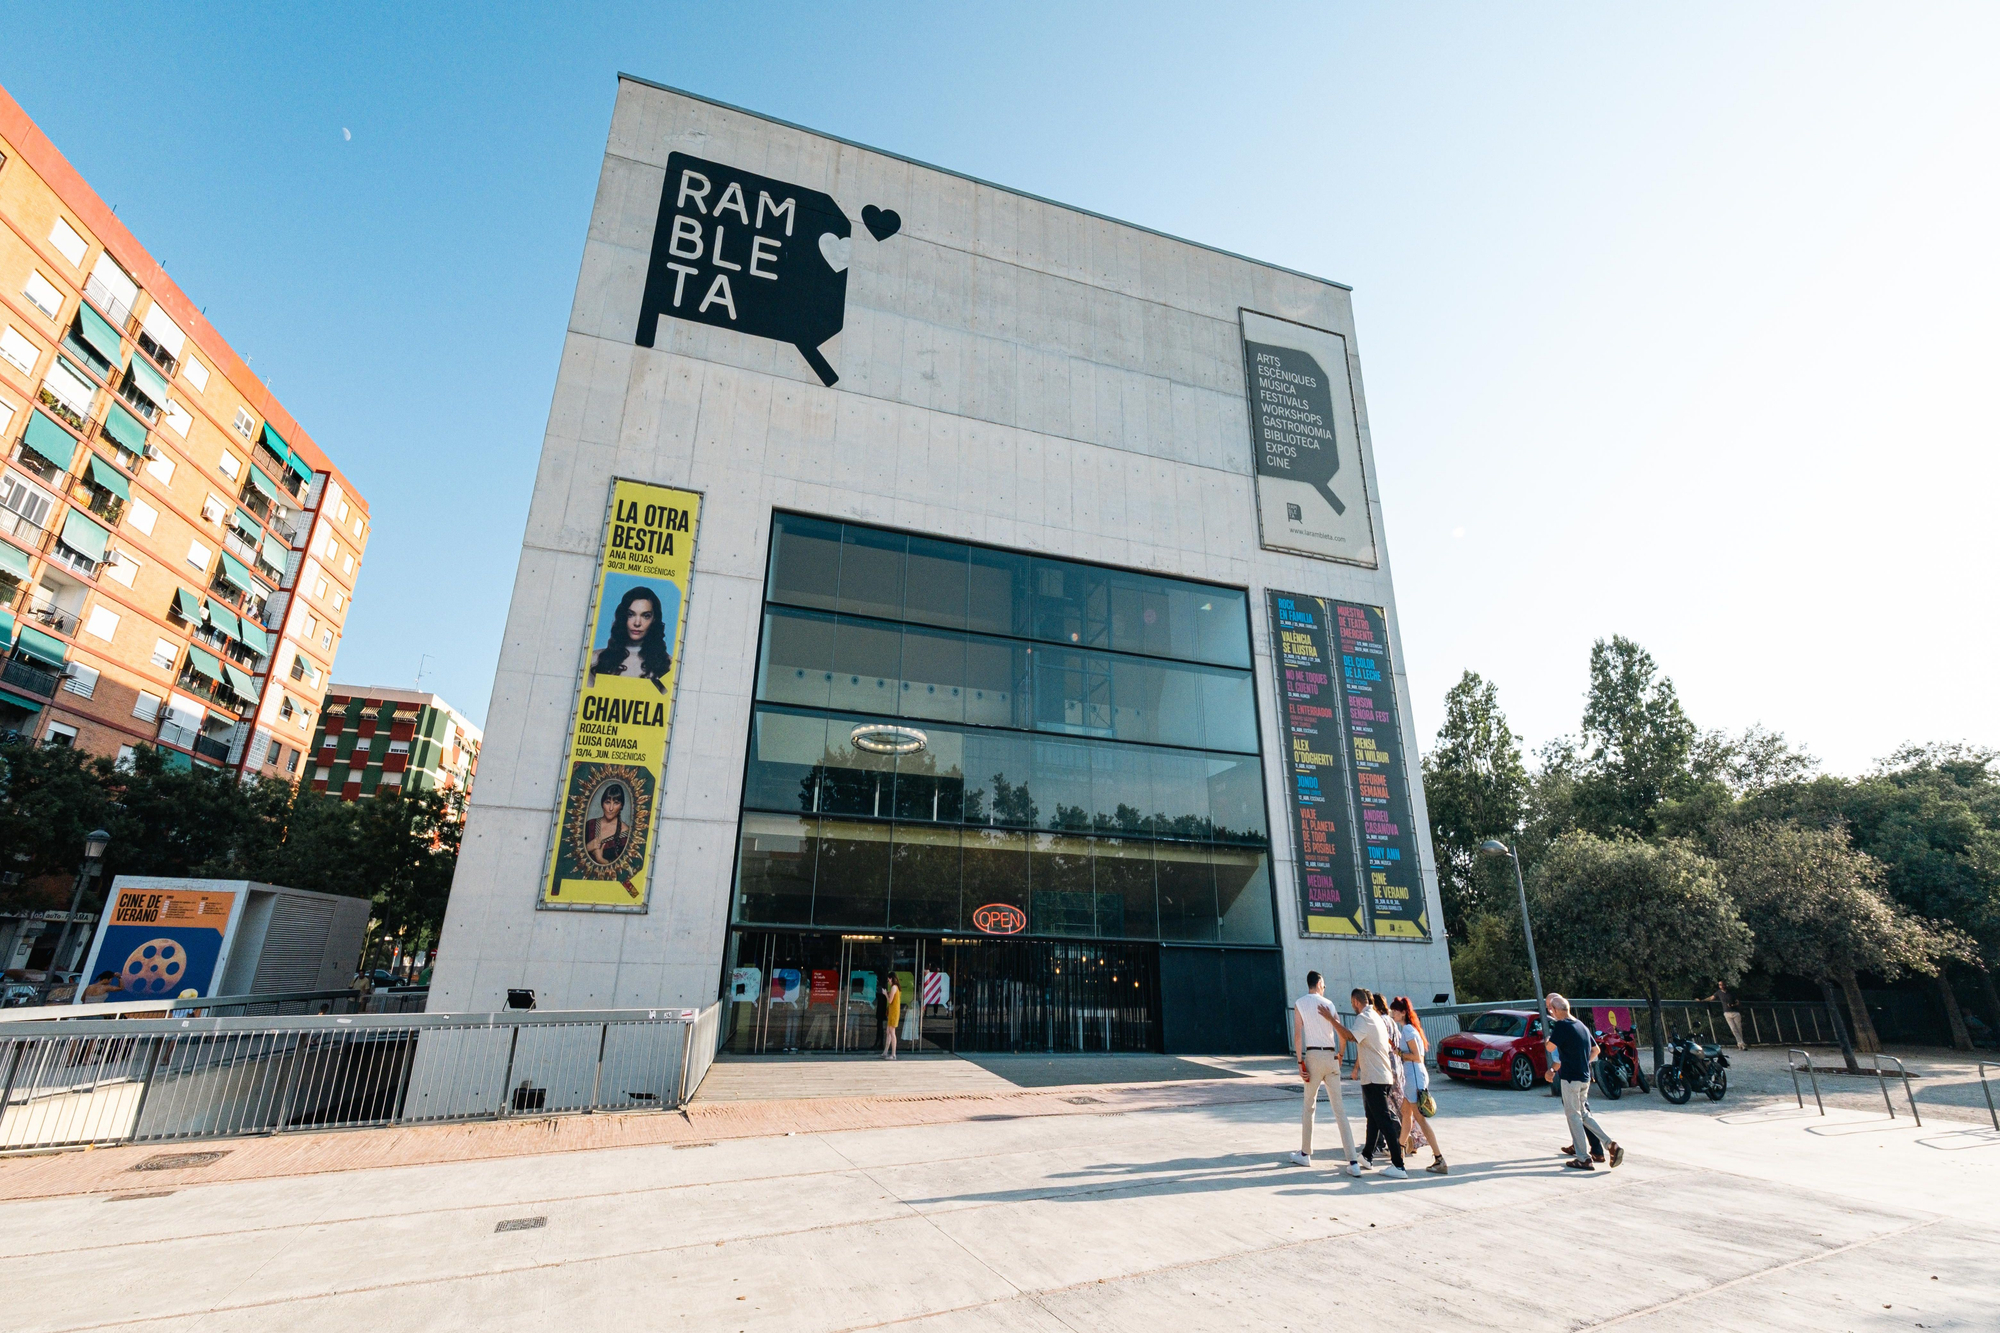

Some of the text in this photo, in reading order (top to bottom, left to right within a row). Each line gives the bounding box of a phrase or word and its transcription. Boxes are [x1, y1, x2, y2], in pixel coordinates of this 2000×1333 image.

[676, 169, 797, 237] RAM
[668, 214, 783, 281] BLE
[666, 261, 738, 321] TA
[1257, 353, 1280, 367] ARTS
[1259, 377, 1296, 395] MÚSICA
[1260, 390, 1309, 410] FESTIVALS
[1261, 402, 1322, 426] WORKSHOPS
[1263, 416, 1332, 440] GASTRONOMIA
[1264, 428, 1320, 450] BIBLIOTECA
[1266, 442, 1297, 457] EXPOS
[1267, 455, 1290, 469] CINE
[616, 499, 688, 532] LA OTRA
[612, 524, 673, 556] BESTIA
[1289, 526, 1346, 542] www.larambleta.com
[609, 550, 654, 564] ANA RUJAS
[1278, 598, 1295, 610] ROCK
[1279, 609, 1313, 624] EN FAMILIA
[1337, 606, 1365, 619] MUESTRA
[1339, 617, 1369, 630] DE TEATRO
[1340, 627, 1374, 642] EMERGENTE
[1283, 642, 1318, 657] SE ILUSTRA
[1343, 655, 1375, 669] DEL COLOR
[1286, 669, 1327, 684] NO ME TOQUES
[1345, 667, 1353, 677] DE
[1354, 668, 1362, 679] LA
[1363, 669, 1381, 682] LECHE
[1287, 681, 1318, 694] EL CUENTO
[1349, 696, 1373, 709] BENSON
[582, 696, 664, 727] CHAVELA
[1289, 704, 1332, 718] EL ENTERRADOR
[1375, 711, 1389, 723] FEST
[580, 723, 618, 735] ROZALÉN
[578, 735, 638, 749] LUISA GAVASA
[1294, 736, 1309, 751] ÁLEX
[1353, 737, 1376, 750] PIENSA
[1294, 751, 1333, 766] O'DOGHERTY
[1355, 749, 1389, 763] EN WILBUR
[1297, 775, 1318, 789] JONDO
[1358, 773, 1387, 786] DEFORME
[1360, 785, 1390, 798] SEMANAL
[1300, 808, 1317, 819] VIAJE
[1364, 809, 1388, 822] ANDREU
[1302, 820, 1335, 832] AL PLANETA
[1365, 822, 1399, 835] CASANOVA
[1303, 831, 1326, 842] DE TODO
[1304, 842, 1335, 854] ES POSIBLE
[1368, 846, 1400, 860] TONY ANN
[1307, 875, 1333, 888] MEDINA
[1372, 872, 1387, 885] CINE
[1309, 888, 1340, 902] AZAHARA
[1373, 885, 1409, 899] DE VERANO
[119, 894, 163, 909] CINE DE
[116, 908, 158, 922] VERANO
[979, 912, 1020, 928] OPEN
